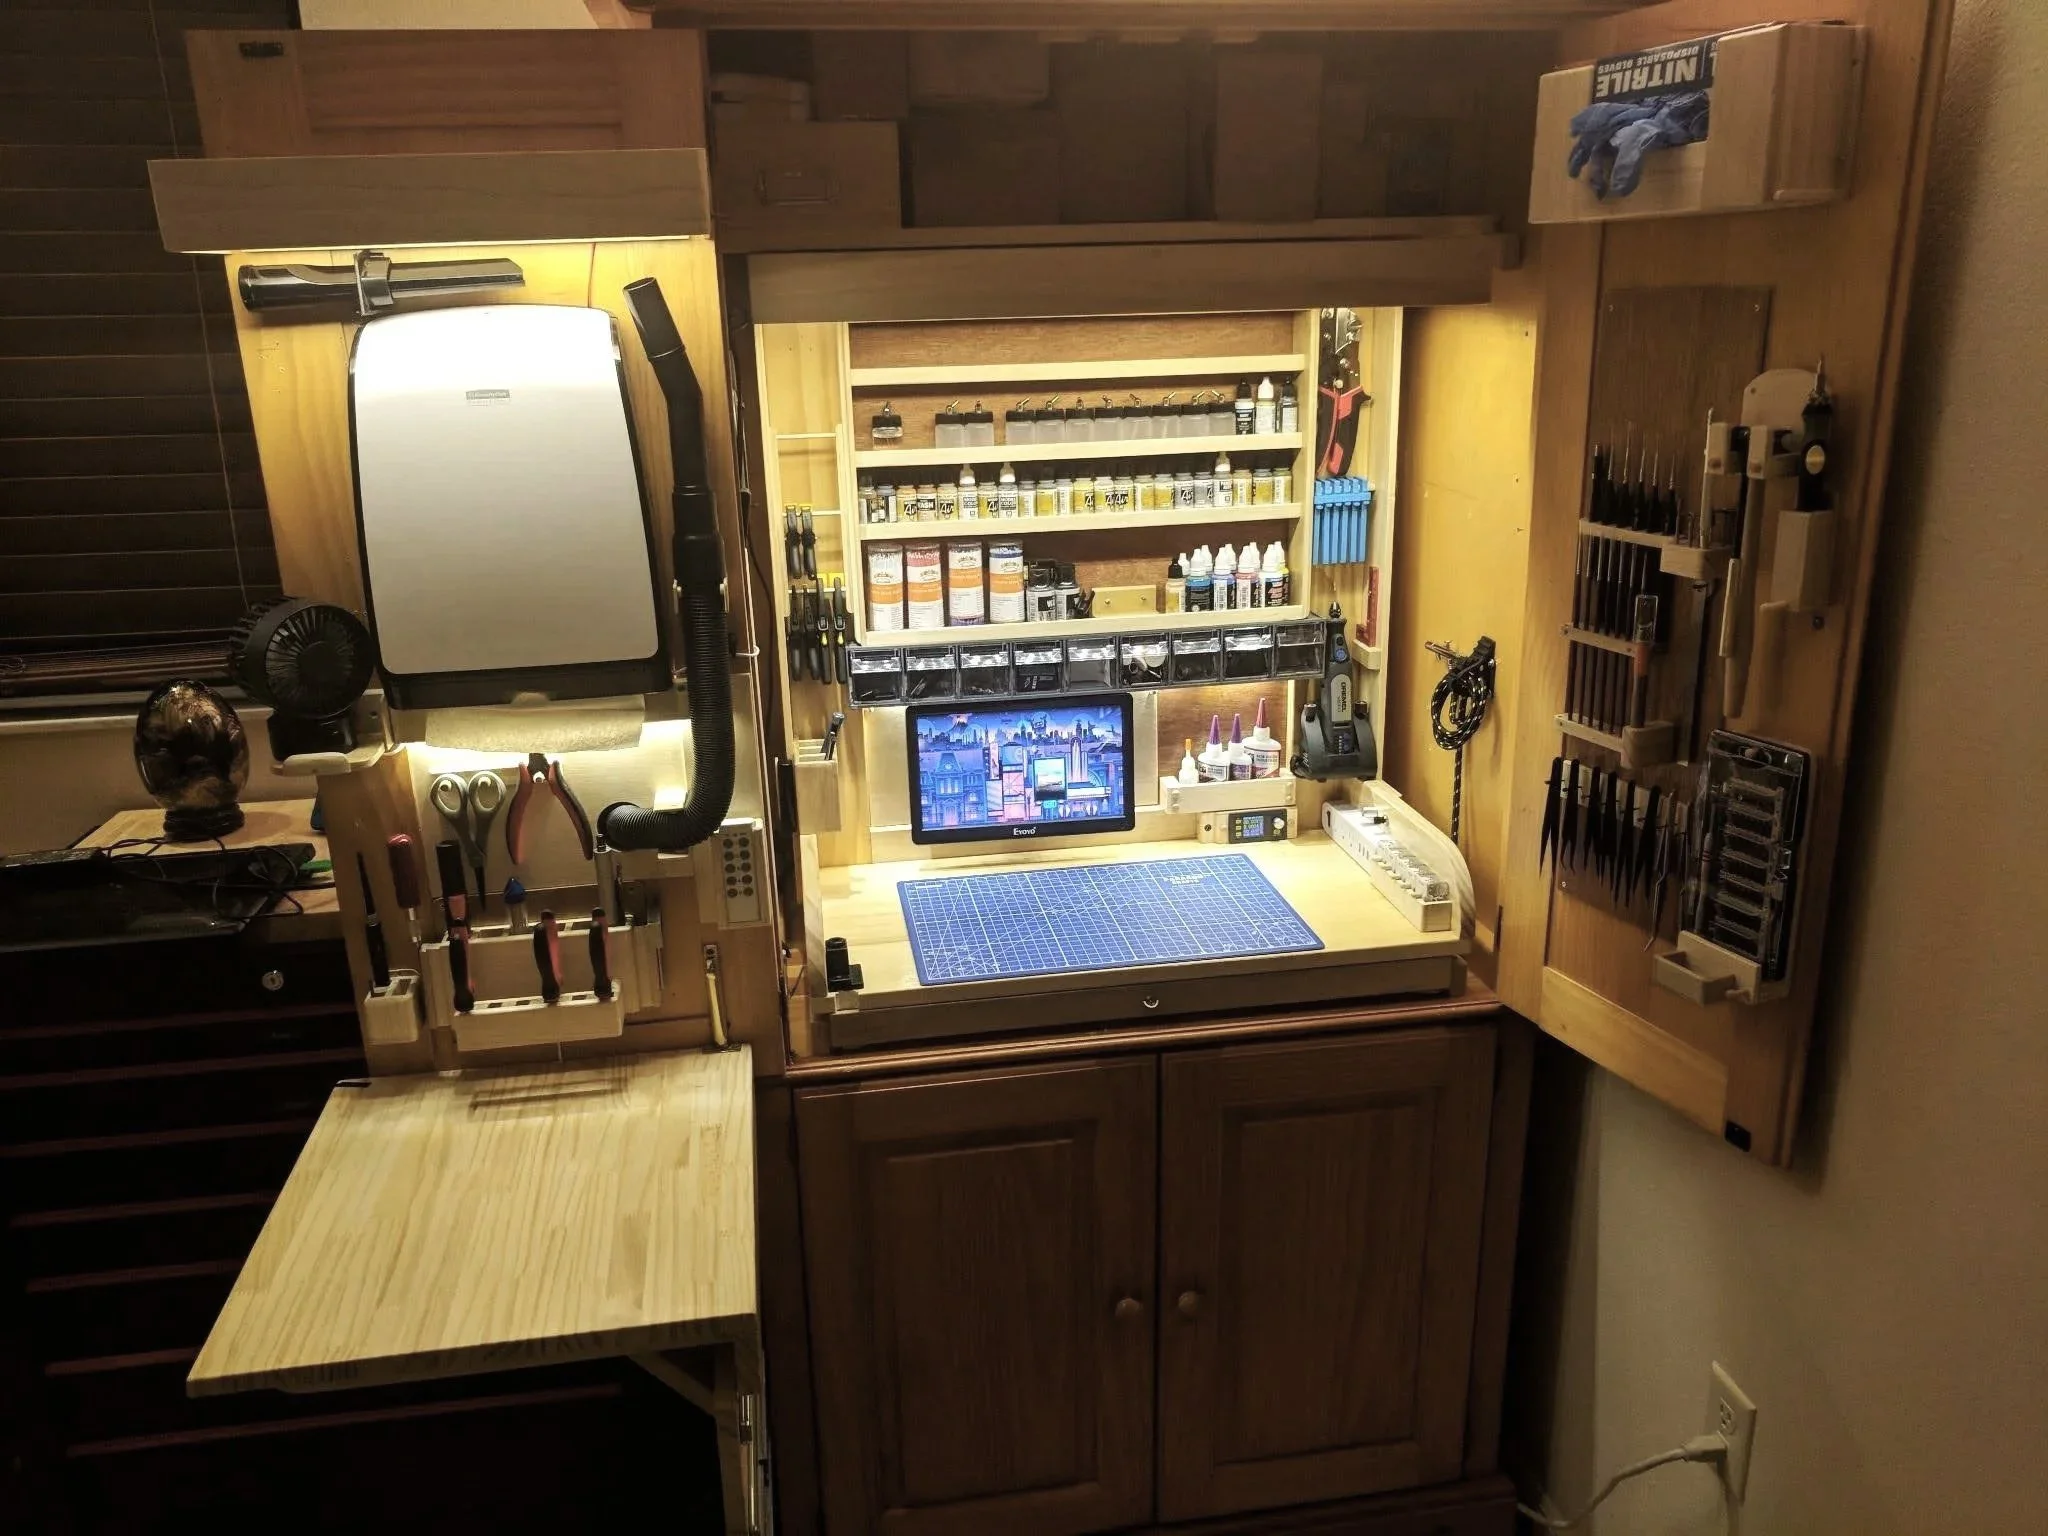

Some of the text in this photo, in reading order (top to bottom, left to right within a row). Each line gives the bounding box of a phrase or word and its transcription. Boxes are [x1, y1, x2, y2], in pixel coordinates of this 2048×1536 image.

[1597, 58, 1634, 75] GLOVES
[1636, 45, 1700, 67] DISPOSABLE
[1596, 56, 1697, 97] NITRILE
